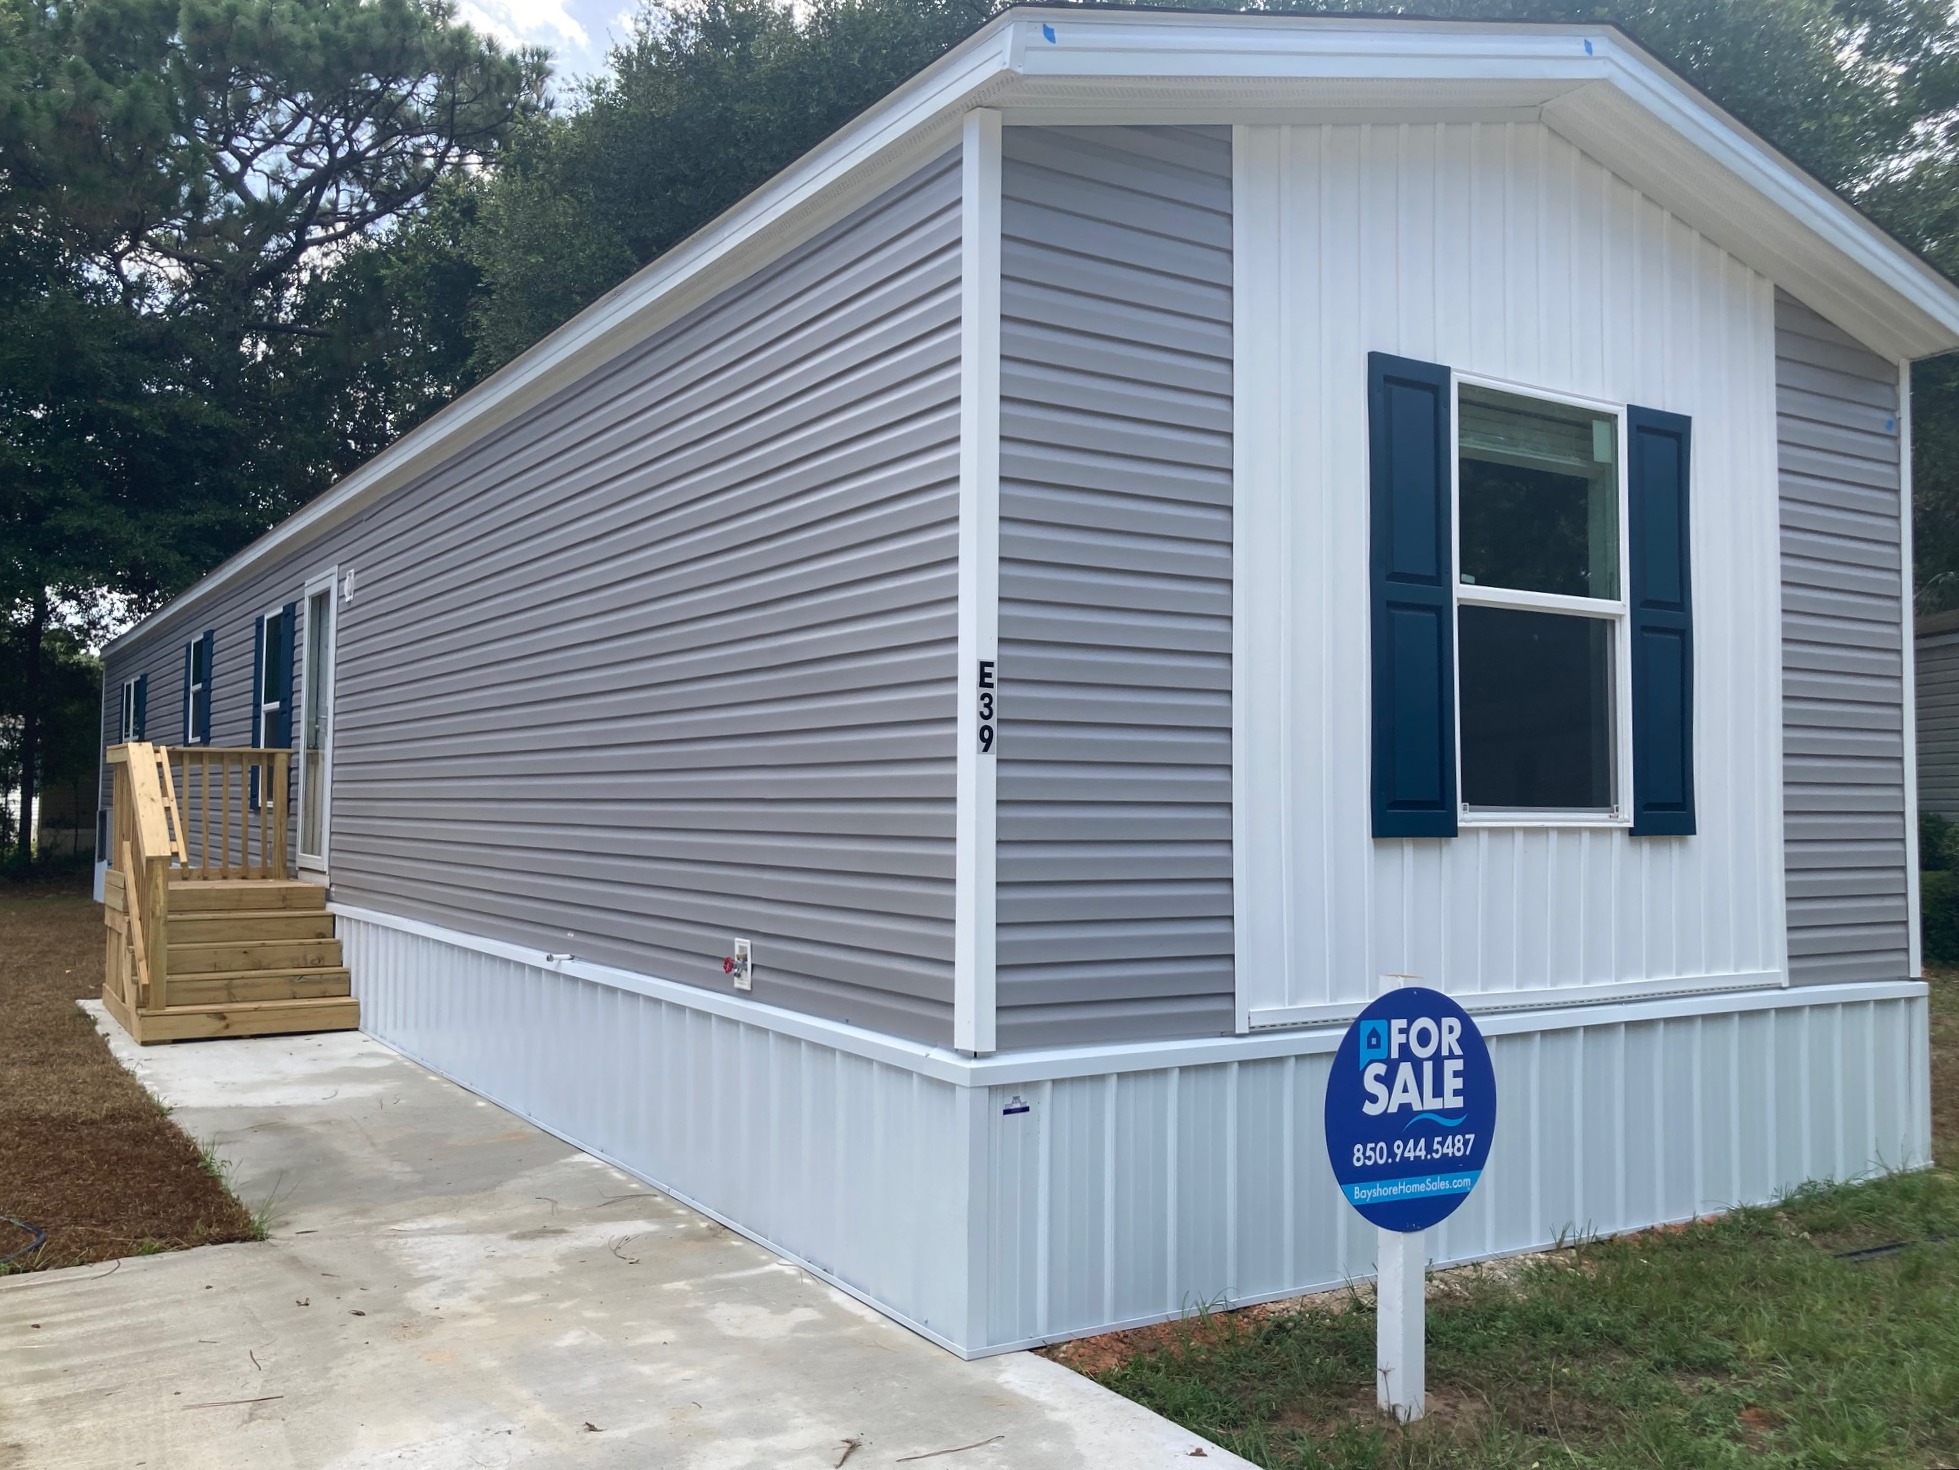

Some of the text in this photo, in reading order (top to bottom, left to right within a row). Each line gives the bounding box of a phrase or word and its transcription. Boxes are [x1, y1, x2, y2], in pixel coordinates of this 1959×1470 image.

[979, 661, 994, 752] E39
[1390, 1017, 1463, 1059] FOR
[1362, 1059, 1464, 1116] SALE
[1352, 1134, 1475, 1167] 850.944.5487
[1354, 1176, 1471, 1202] BayshoreHomeSales.com
